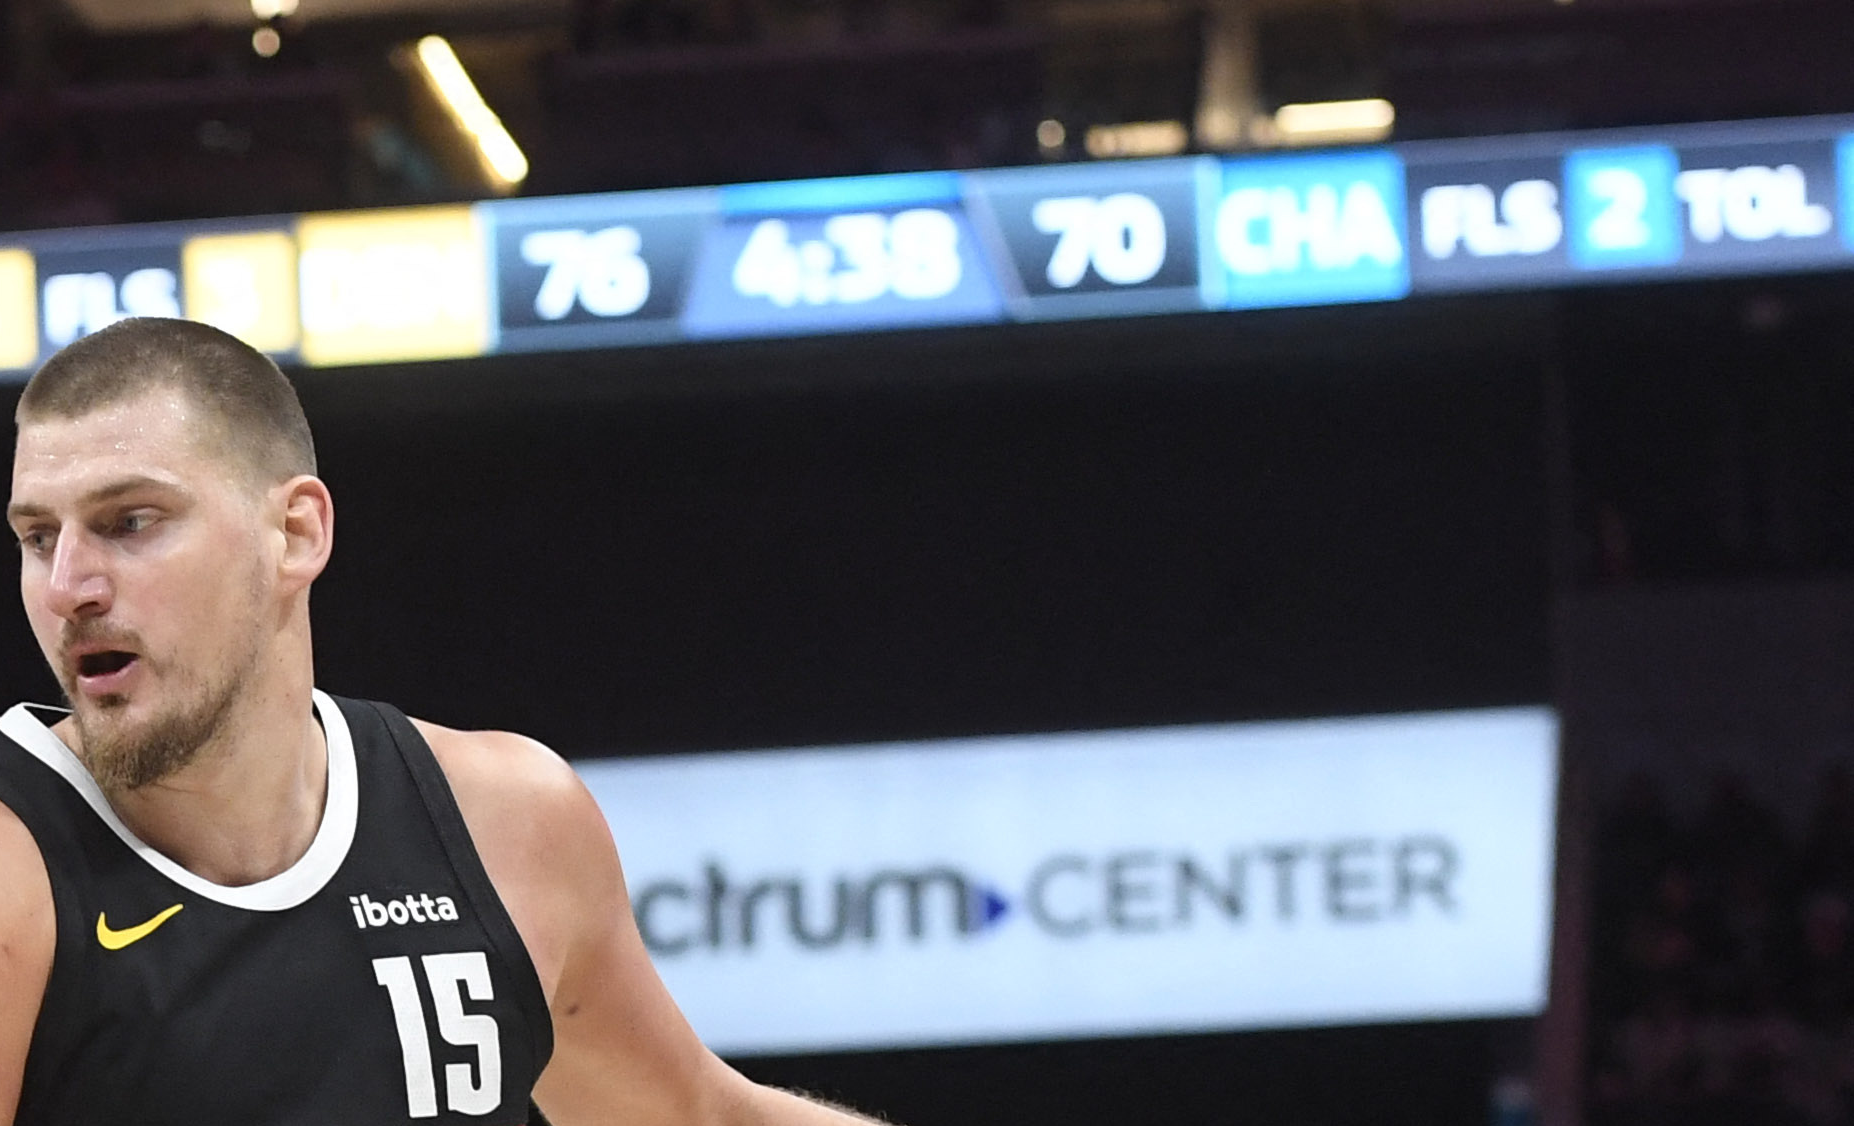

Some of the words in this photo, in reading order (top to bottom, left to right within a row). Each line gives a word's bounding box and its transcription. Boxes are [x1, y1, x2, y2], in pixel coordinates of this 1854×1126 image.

[1033, 193, 1165, 289] 70
[1217, 181, 1401, 275] CHA
[1422, 179, 1561, 260] FLS
[1584, 168, 1651, 250] 2
[1673, 163, 1831, 243] TOL
[521, 226, 650, 319] 76
[733, 209, 960, 306] 4:38
[349, 894, 459, 928] ibotta
[633, 862, 972, 959] ctrum
[1024, 835, 1460, 939] CENTER
[372, 951, 501, 1118] 15
